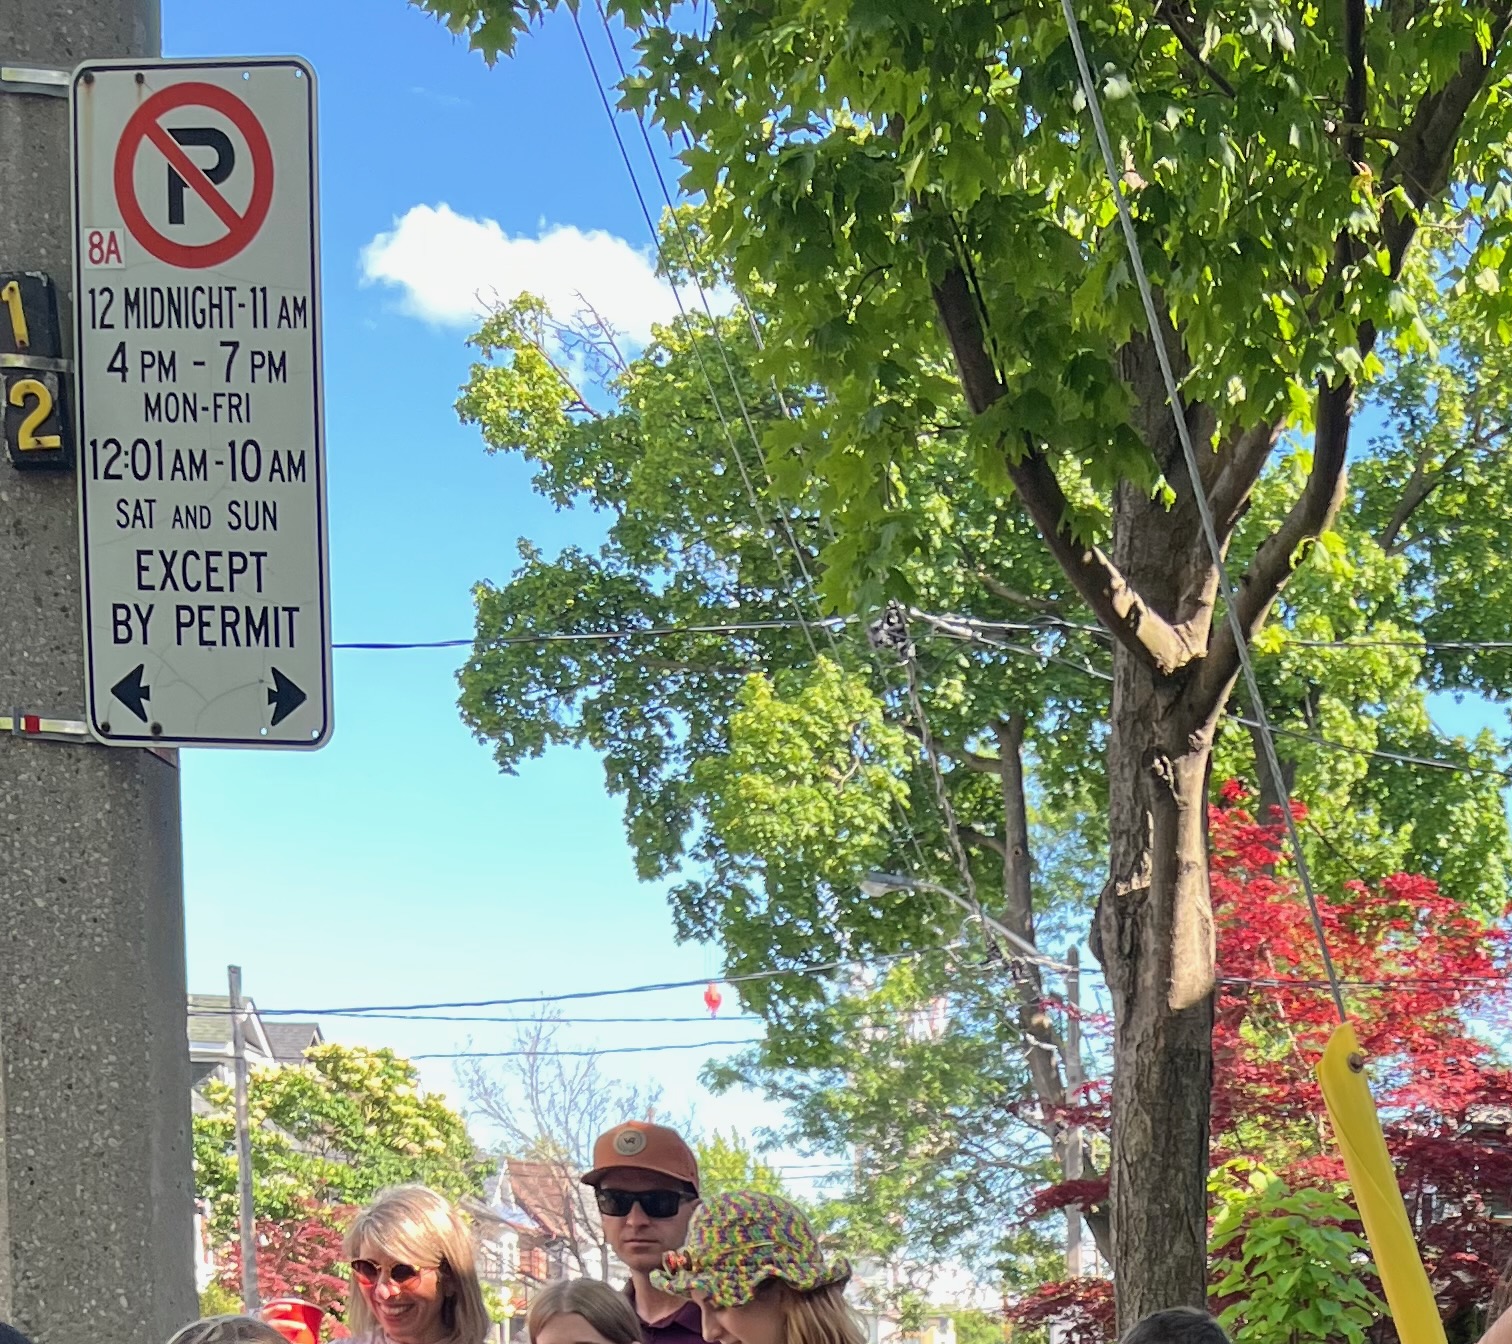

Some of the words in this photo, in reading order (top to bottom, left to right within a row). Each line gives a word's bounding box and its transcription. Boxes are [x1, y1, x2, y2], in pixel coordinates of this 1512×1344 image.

[88, 230, 123, 266] 8A
[88, 286, 115, 329] 12
[277, 295, 308, 329] AM
[106, 341, 129, 383] 4
[141, 350, 177, 383] PM
[219, 341, 240, 383] 7
[250, 350, 287, 383] PM
[144, 391, 251, 423] MON-FRI
[268, 449, 307, 483] AM
[115, 498, 157, 530] SAT
[171, 505, 212, 530] AND
[227, 500, 278, 532] SUN
[135, 549, 268, 593] EXCEPT
[112, 602, 155, 645] BY
[175, 604, 300, 648] PERMIT
